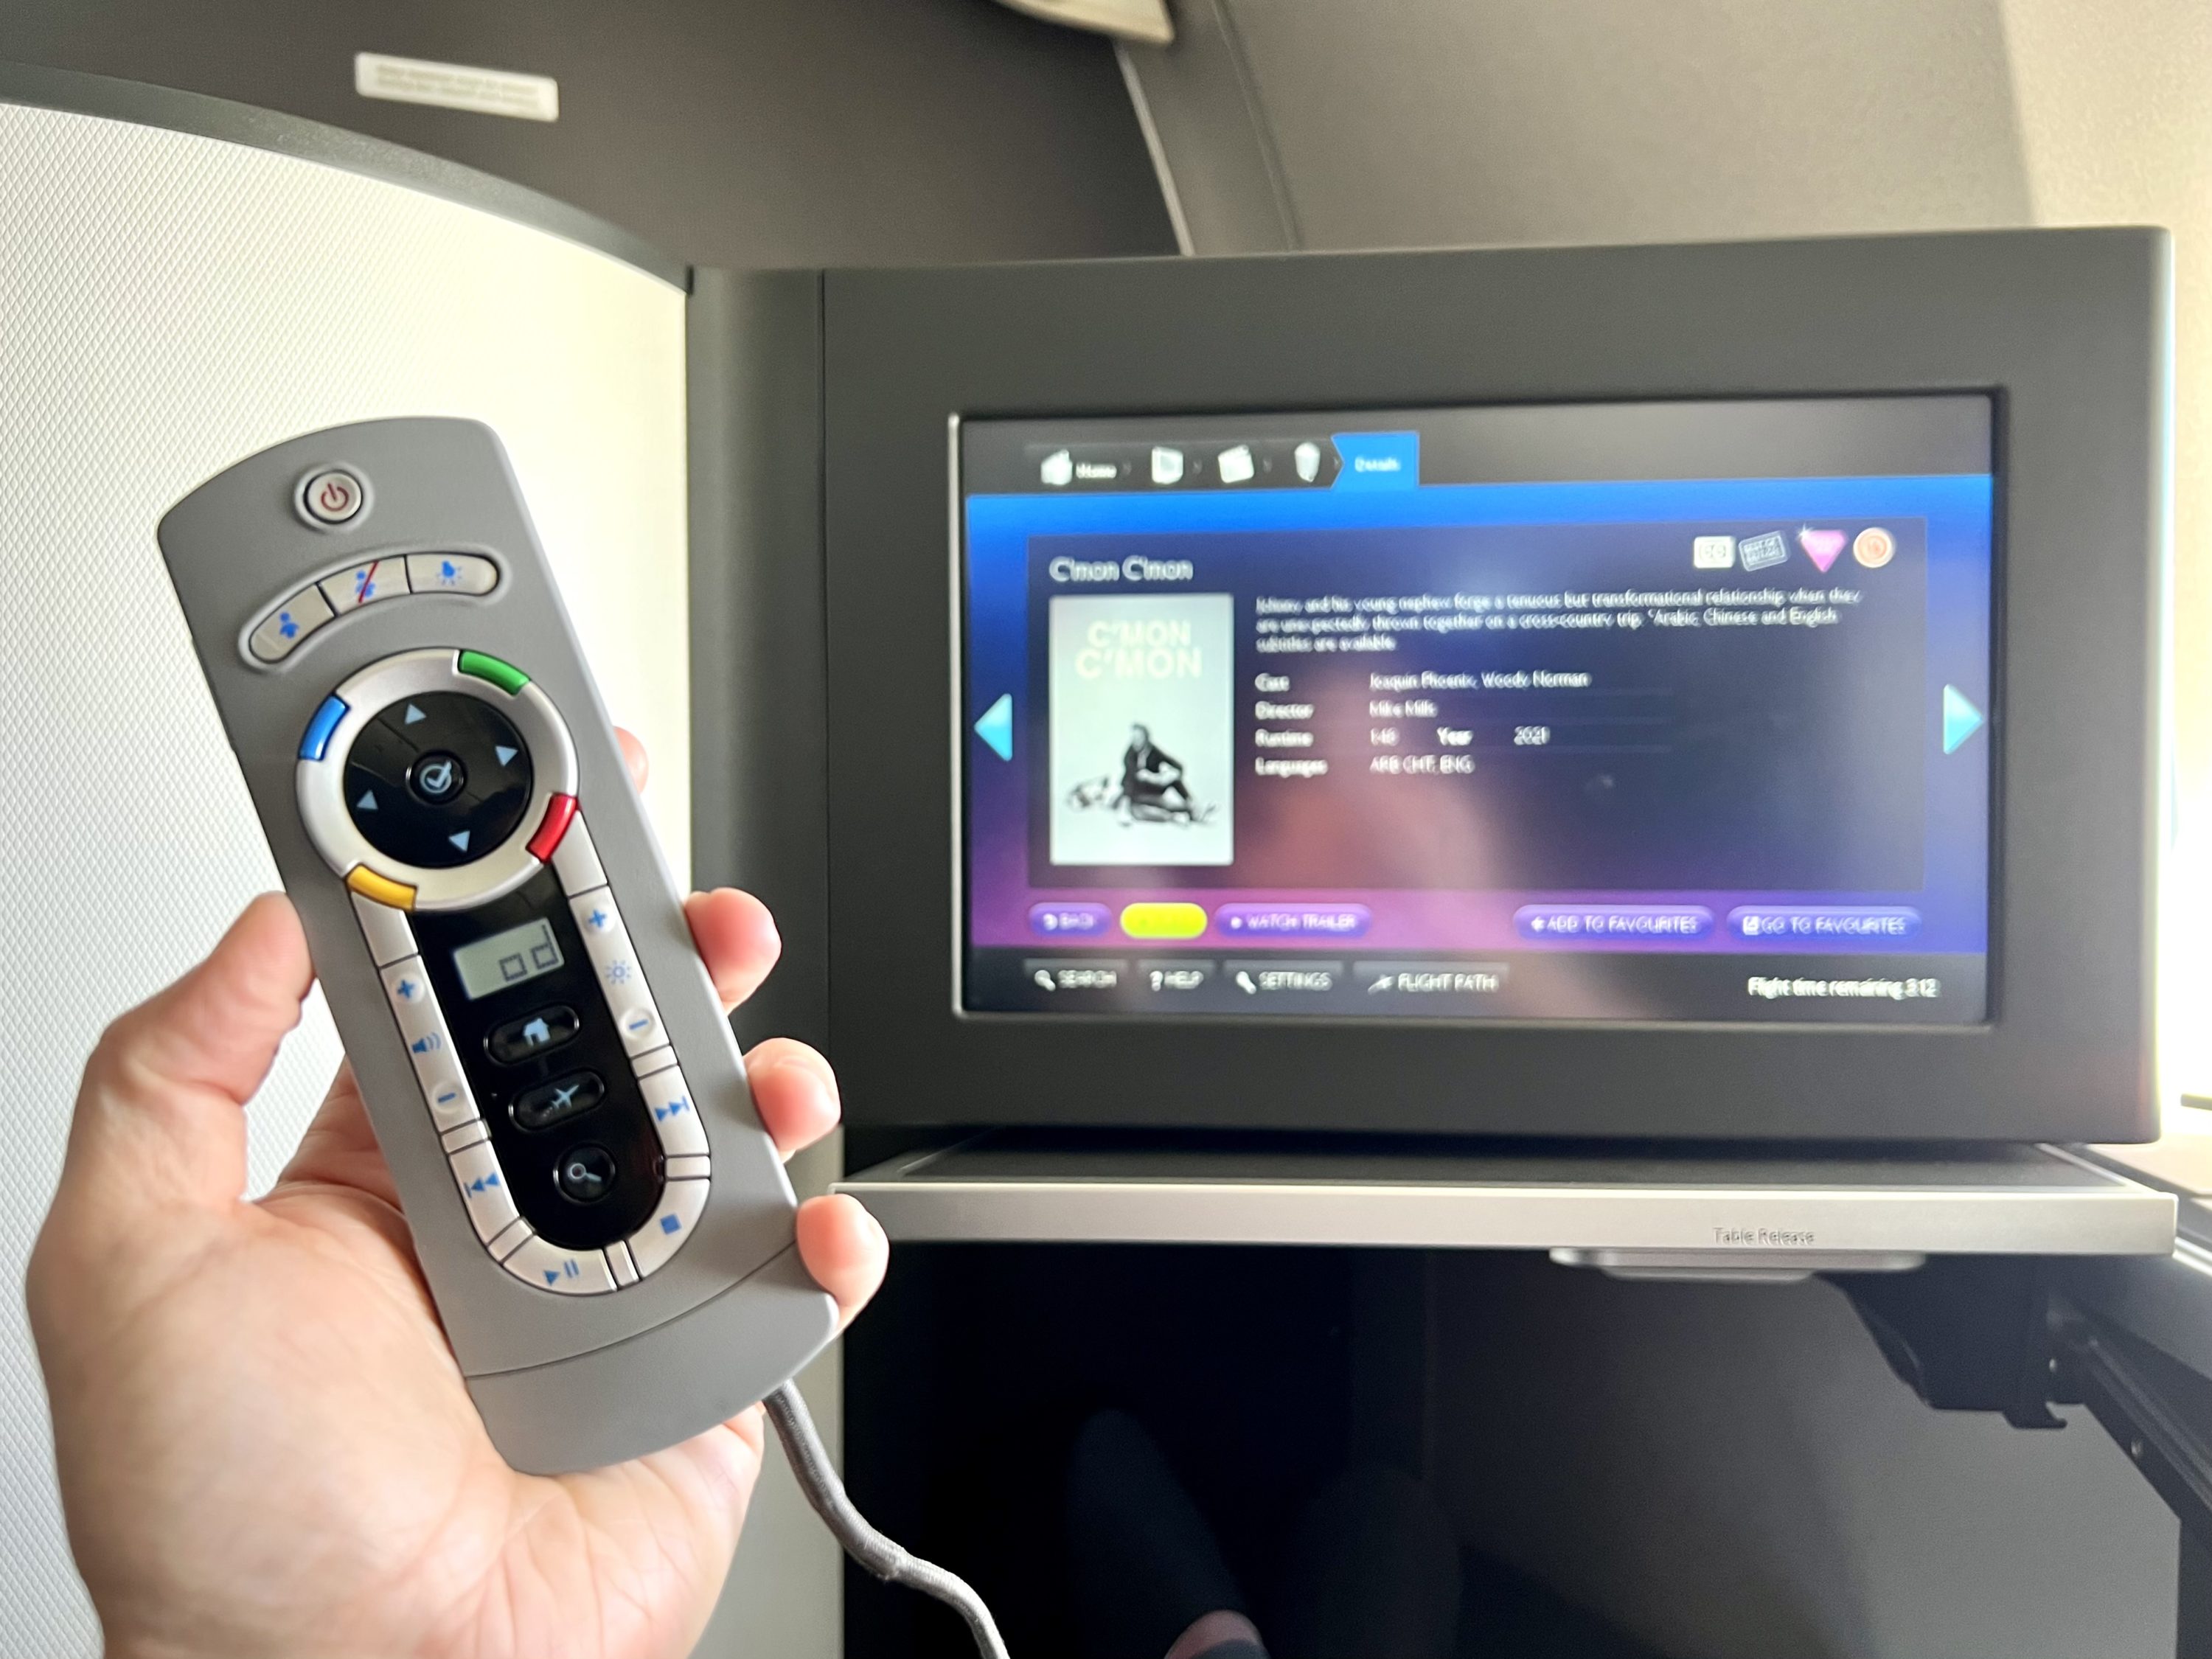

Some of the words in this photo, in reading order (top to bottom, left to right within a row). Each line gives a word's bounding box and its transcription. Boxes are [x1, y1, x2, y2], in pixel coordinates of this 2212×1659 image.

[1048, 557, 1120, 582] C'mon
[1121, 555, 1194, 581] C'mon
[1354, 596, 1399, 615] young
[1506, 593, 1562, 611] tenuous
[1564, 590, 1590, 609] but
[1591, 588, 1704, 608] transformational
[1705, 588, 1787, 608] relationship
[1789, 587, 1826, 605] when
[1829, 586, 1863, 607] they
[1371, 613, 1422, 631] thrown
[1423, 611, 1484, 634] together
[1703, 606, 1759, 626] Chinese
[1761, 606, 1789, 626] and
[1790, 605, 1840, 628] English
[1086, 620, 1192, 649] C'MON
[1075, 646, 1203, 680] C'MON
[1369, 672, 1421, 693] Joaquin
[1481, 669, 1531, 689] Woody
[1532, 669, 1593, 689] Norman
[1369, 700, 1404, 719] Mike
[1547, 914, 1581, 933] ADD
[1584, 914, 1607, 933] TO
[1608, 914, 1702, 935] FAVOURITES
[1814, 916, 1907, 936] FAVOURITES
[1259, 971, 1333, 991] SETTINGS
[1398, 972, 1453, 992] FLIGHT
[1454, 973, 1500, 992] PATH
[1829, 978, 1905, 1001] remaining
[1712, 1227, 1754, 1245] Table
[1757, 1227, 1815, 1246] Release
